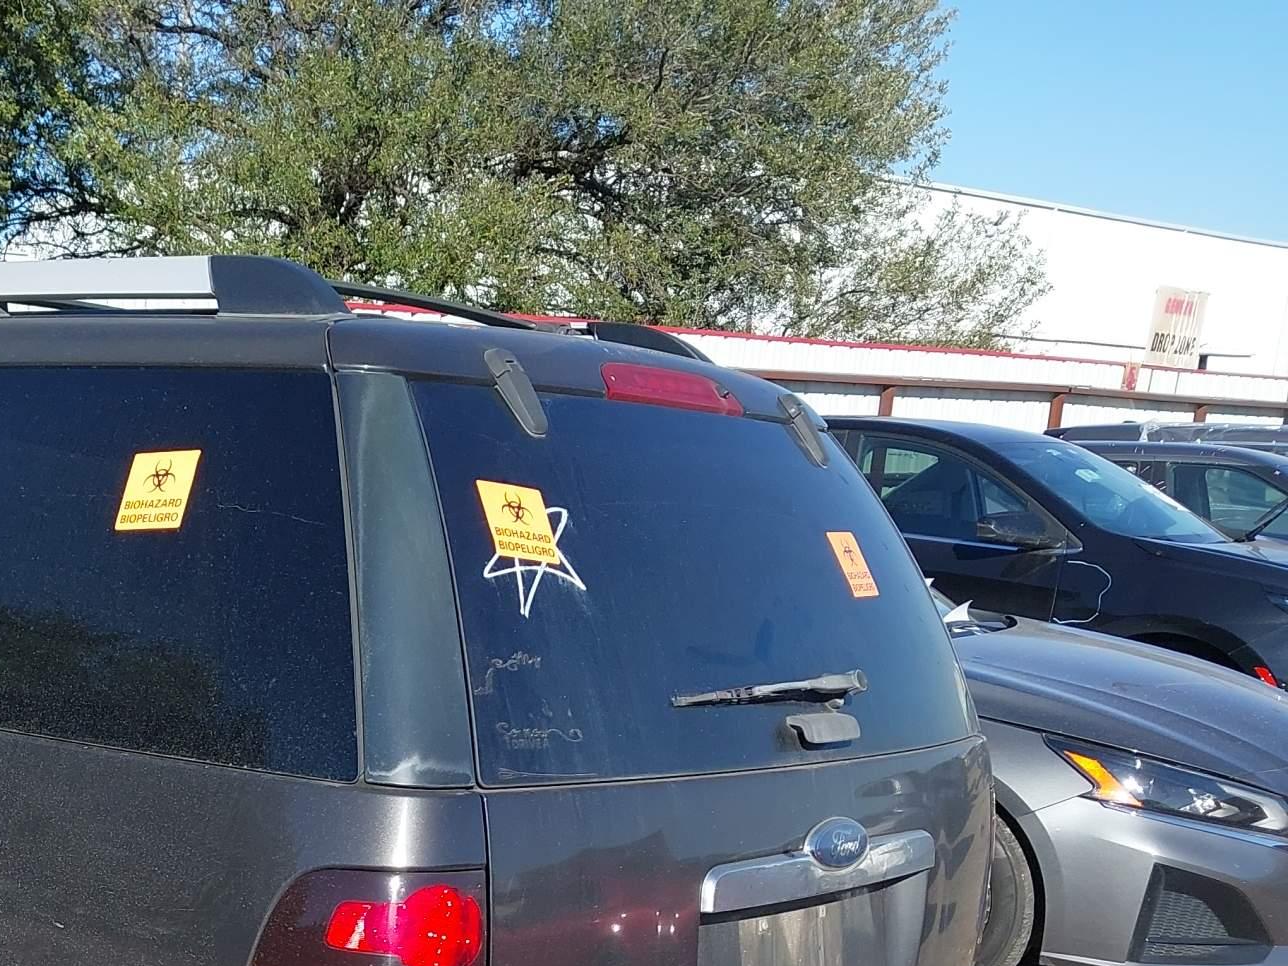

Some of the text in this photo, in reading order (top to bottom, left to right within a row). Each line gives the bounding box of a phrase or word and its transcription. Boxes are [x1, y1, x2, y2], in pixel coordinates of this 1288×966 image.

[1150, 331, 1176, 354] DROP
[123, 498, 183, 511] BIOHAZARD
[119, 512, 179, 524] BIOPELIGRO
[494, 526, 552, 544] BIOHAZARD
[498, 540, 556, 558] BIOPELIGRO
[831, 829, 862, 858] Ford
